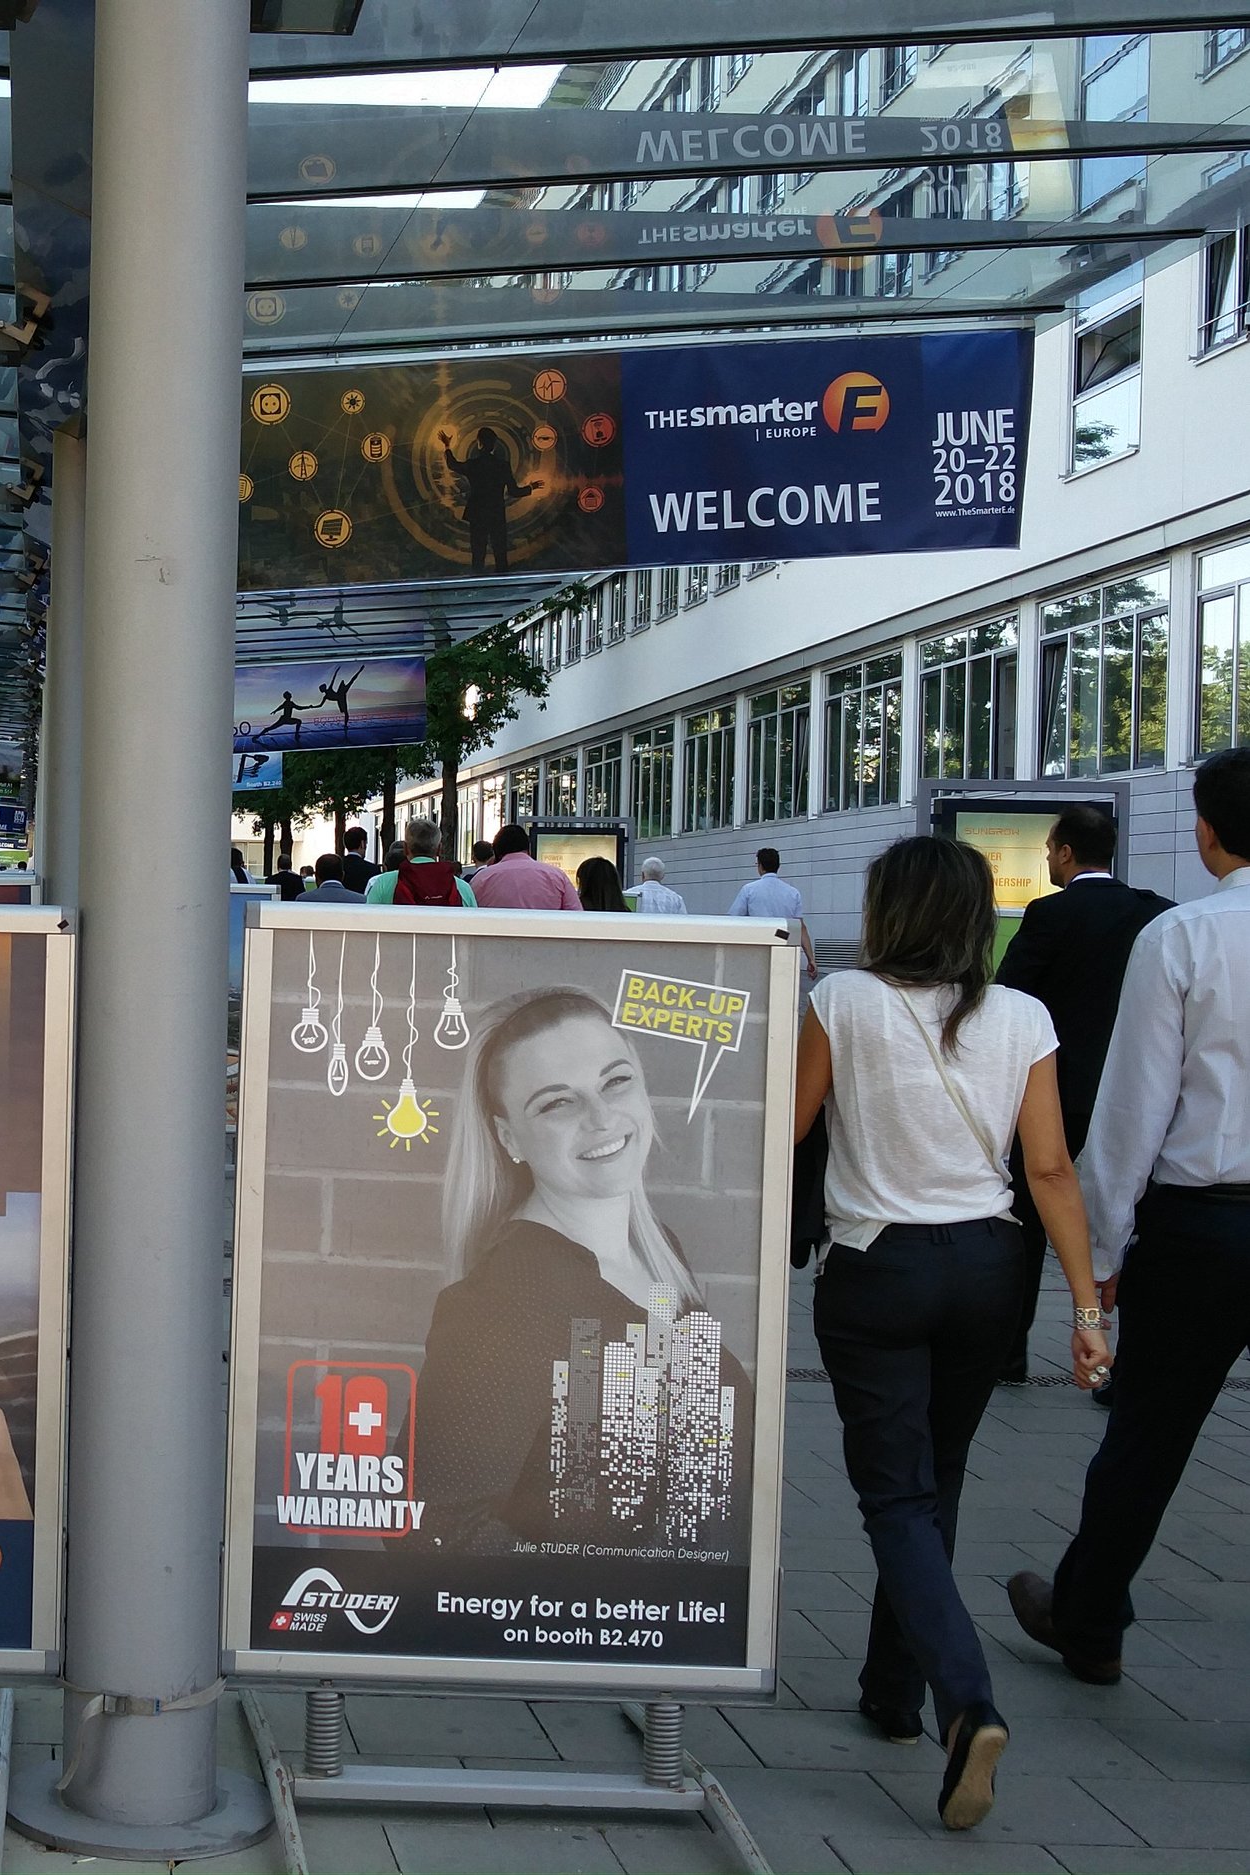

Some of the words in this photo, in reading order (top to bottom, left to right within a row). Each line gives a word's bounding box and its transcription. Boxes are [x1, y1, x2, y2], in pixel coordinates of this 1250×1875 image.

[765, 426, 817, 440] EUROPE
[932, 408, 1016, 447] JUNE
[934, 471, 1016, 506] 2018
[648, 482, 882, 533] WELCOME
[935, 506, 1016, 518] www.TheSmarterE.de
[965, 827, 1020, 836] SUNGROW
[626, 977, 744, 1017] BACK-UP
[621, 1001, 733, 1043] EXPERTS
[314, 1373, 388, 1457] 10
[295, 1452, 404, 1494] YEARS
[276, 1495, 425, 1530] WARRANTY
[512, 1542, 538, 1554] Julie
[540, 1542, 580, 1555] STUDER
[582, 1543, 676, 1560] (Communication
[677, 1548, 729, 1562] Designer)
[292, 1612, 328, 1623] SWISS
[300, 1592, 393, 1611] STUDER
[437, 1591, 524, 1620] Energy
[530, 1595, 564, 1618] for
[570, 1602, 587, 1619] a
[595, 1597, 670, 1622] better
[677, 1600, 726, 1624] Life!
[289, 1621, 325, 1633] MADE
[503, 1627, 529, 1643] on
[534, 1625, 593, 1646] booth
[599, 1628, 664, 1648] B2.470
